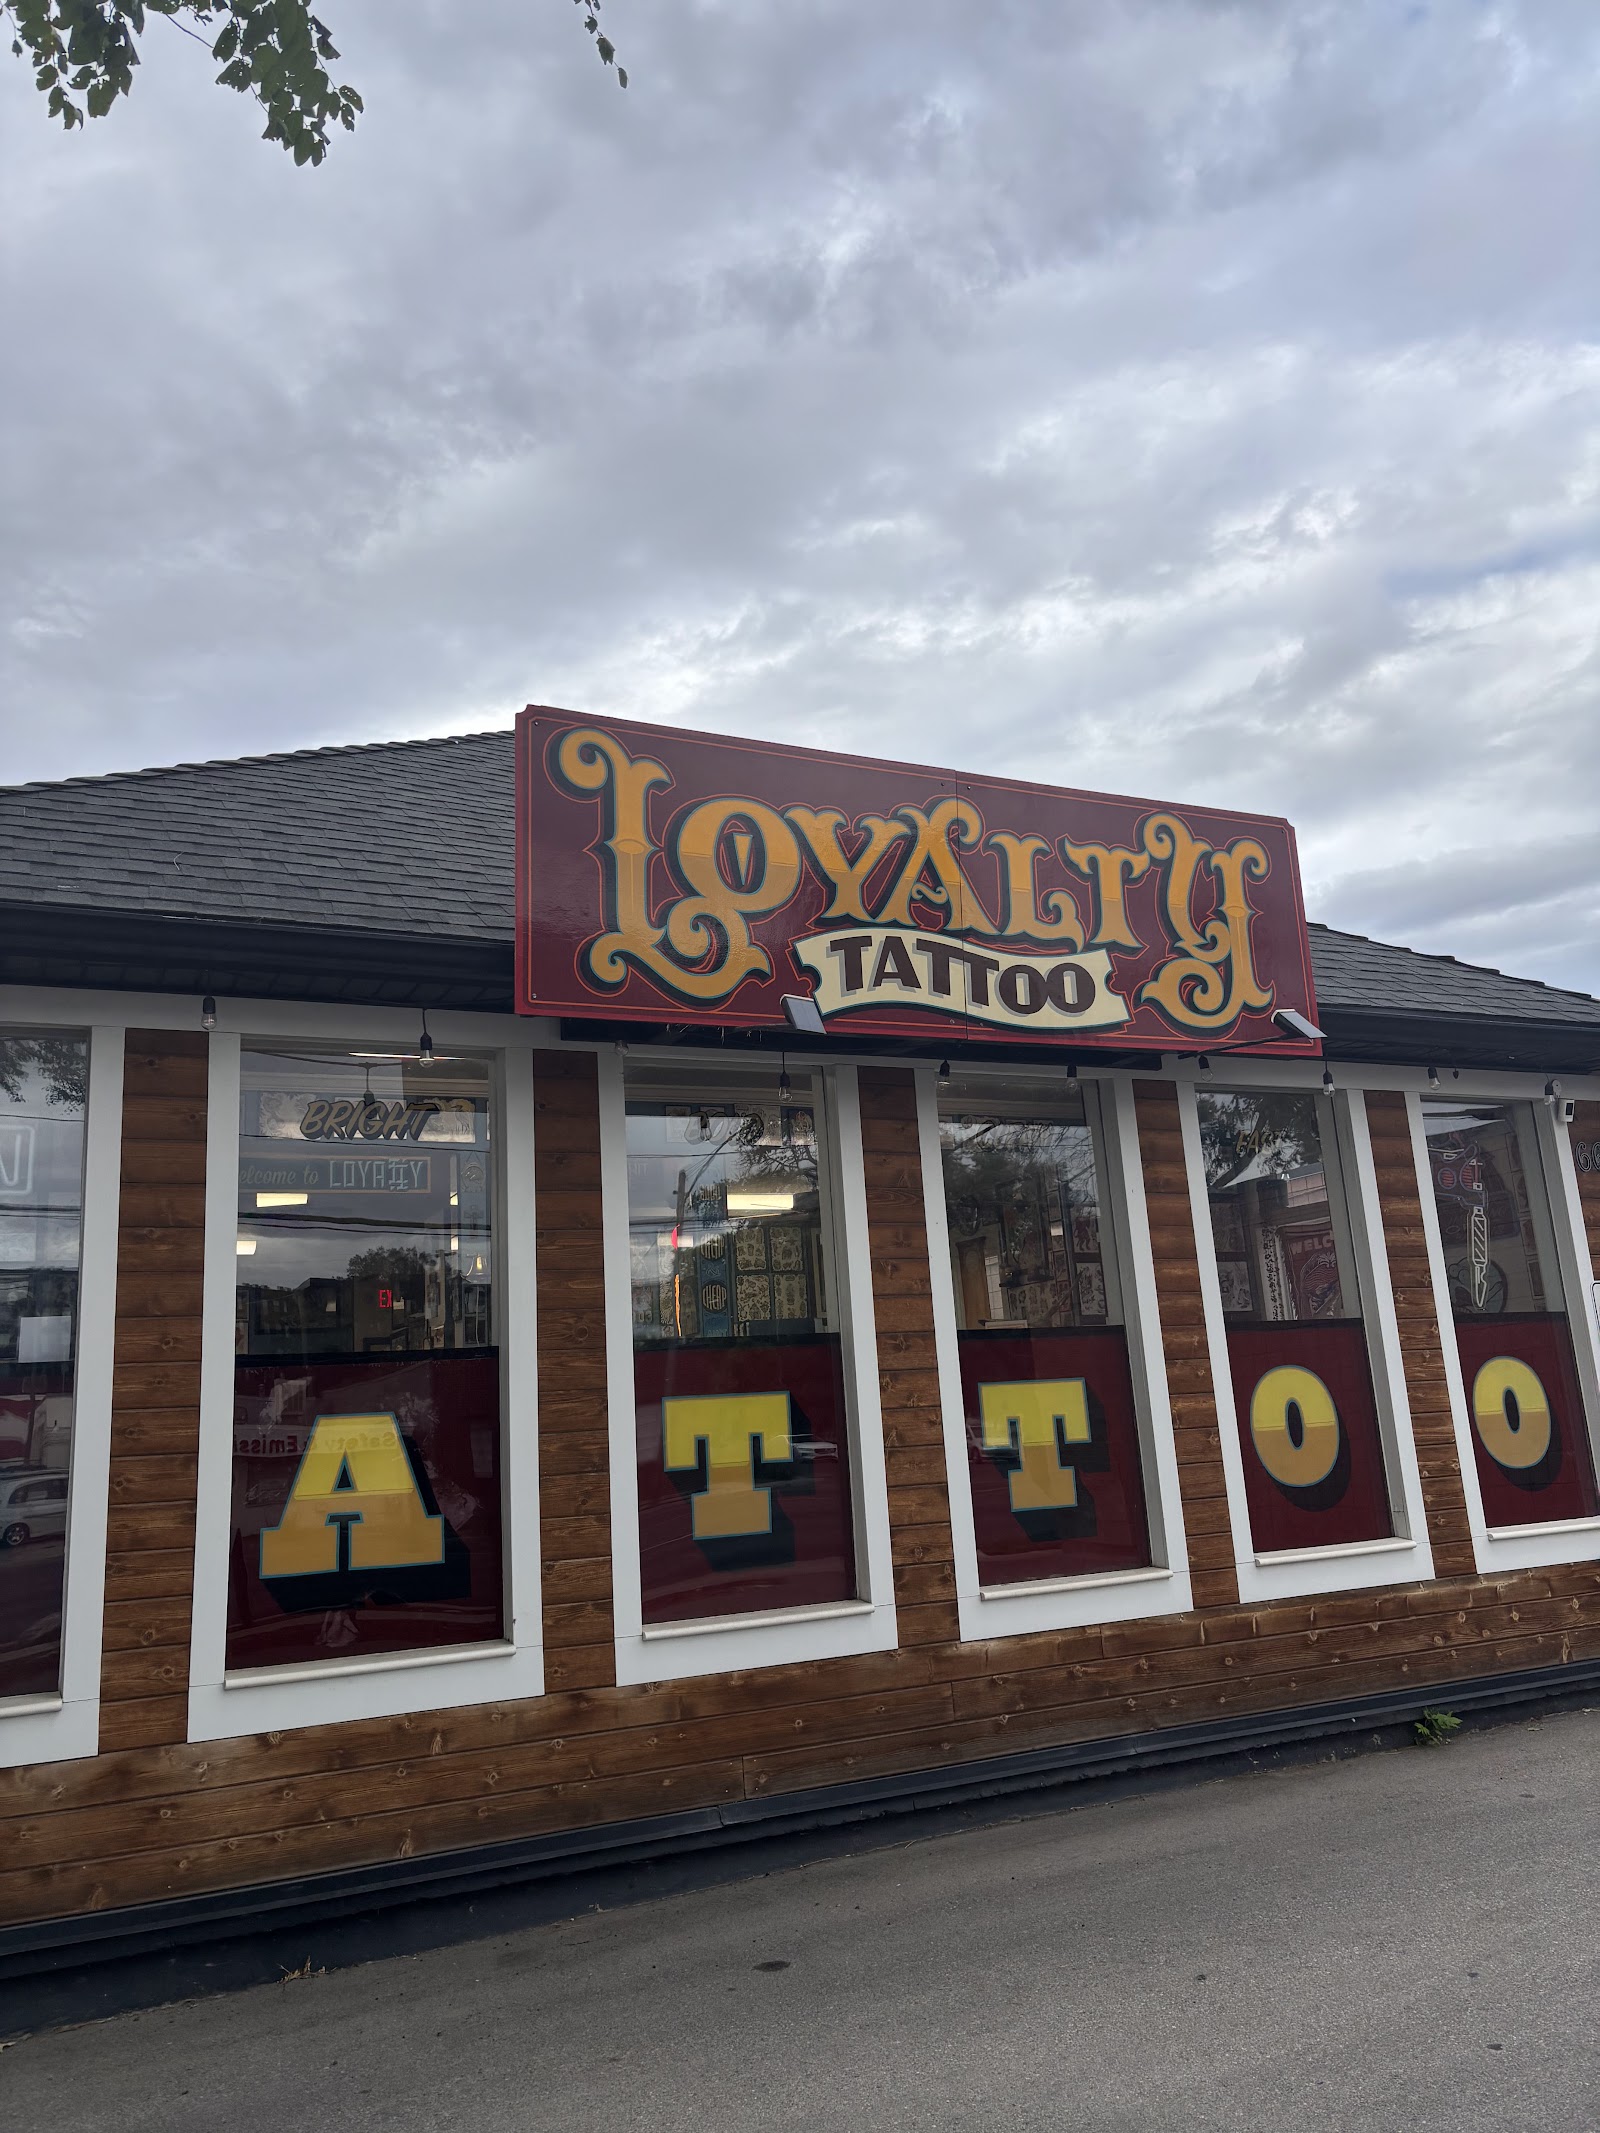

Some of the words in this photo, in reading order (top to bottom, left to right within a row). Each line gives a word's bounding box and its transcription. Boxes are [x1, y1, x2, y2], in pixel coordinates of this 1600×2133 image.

[560, 728, 1272, 1031] LOYALTY
[828, 935, 1096, 1016] TATTOO
[301, 1100, 440, 1140] BRIGHT
[304, 1165, 319, 1185] to
[258, 1412, 445, 1580] A
[661, 1390, 794, 1541] T
[977, 1377, 1092, 1513] T
[1249, 1364, 1341, 1488] O
[1472, 1355, 1552, 1470] O
